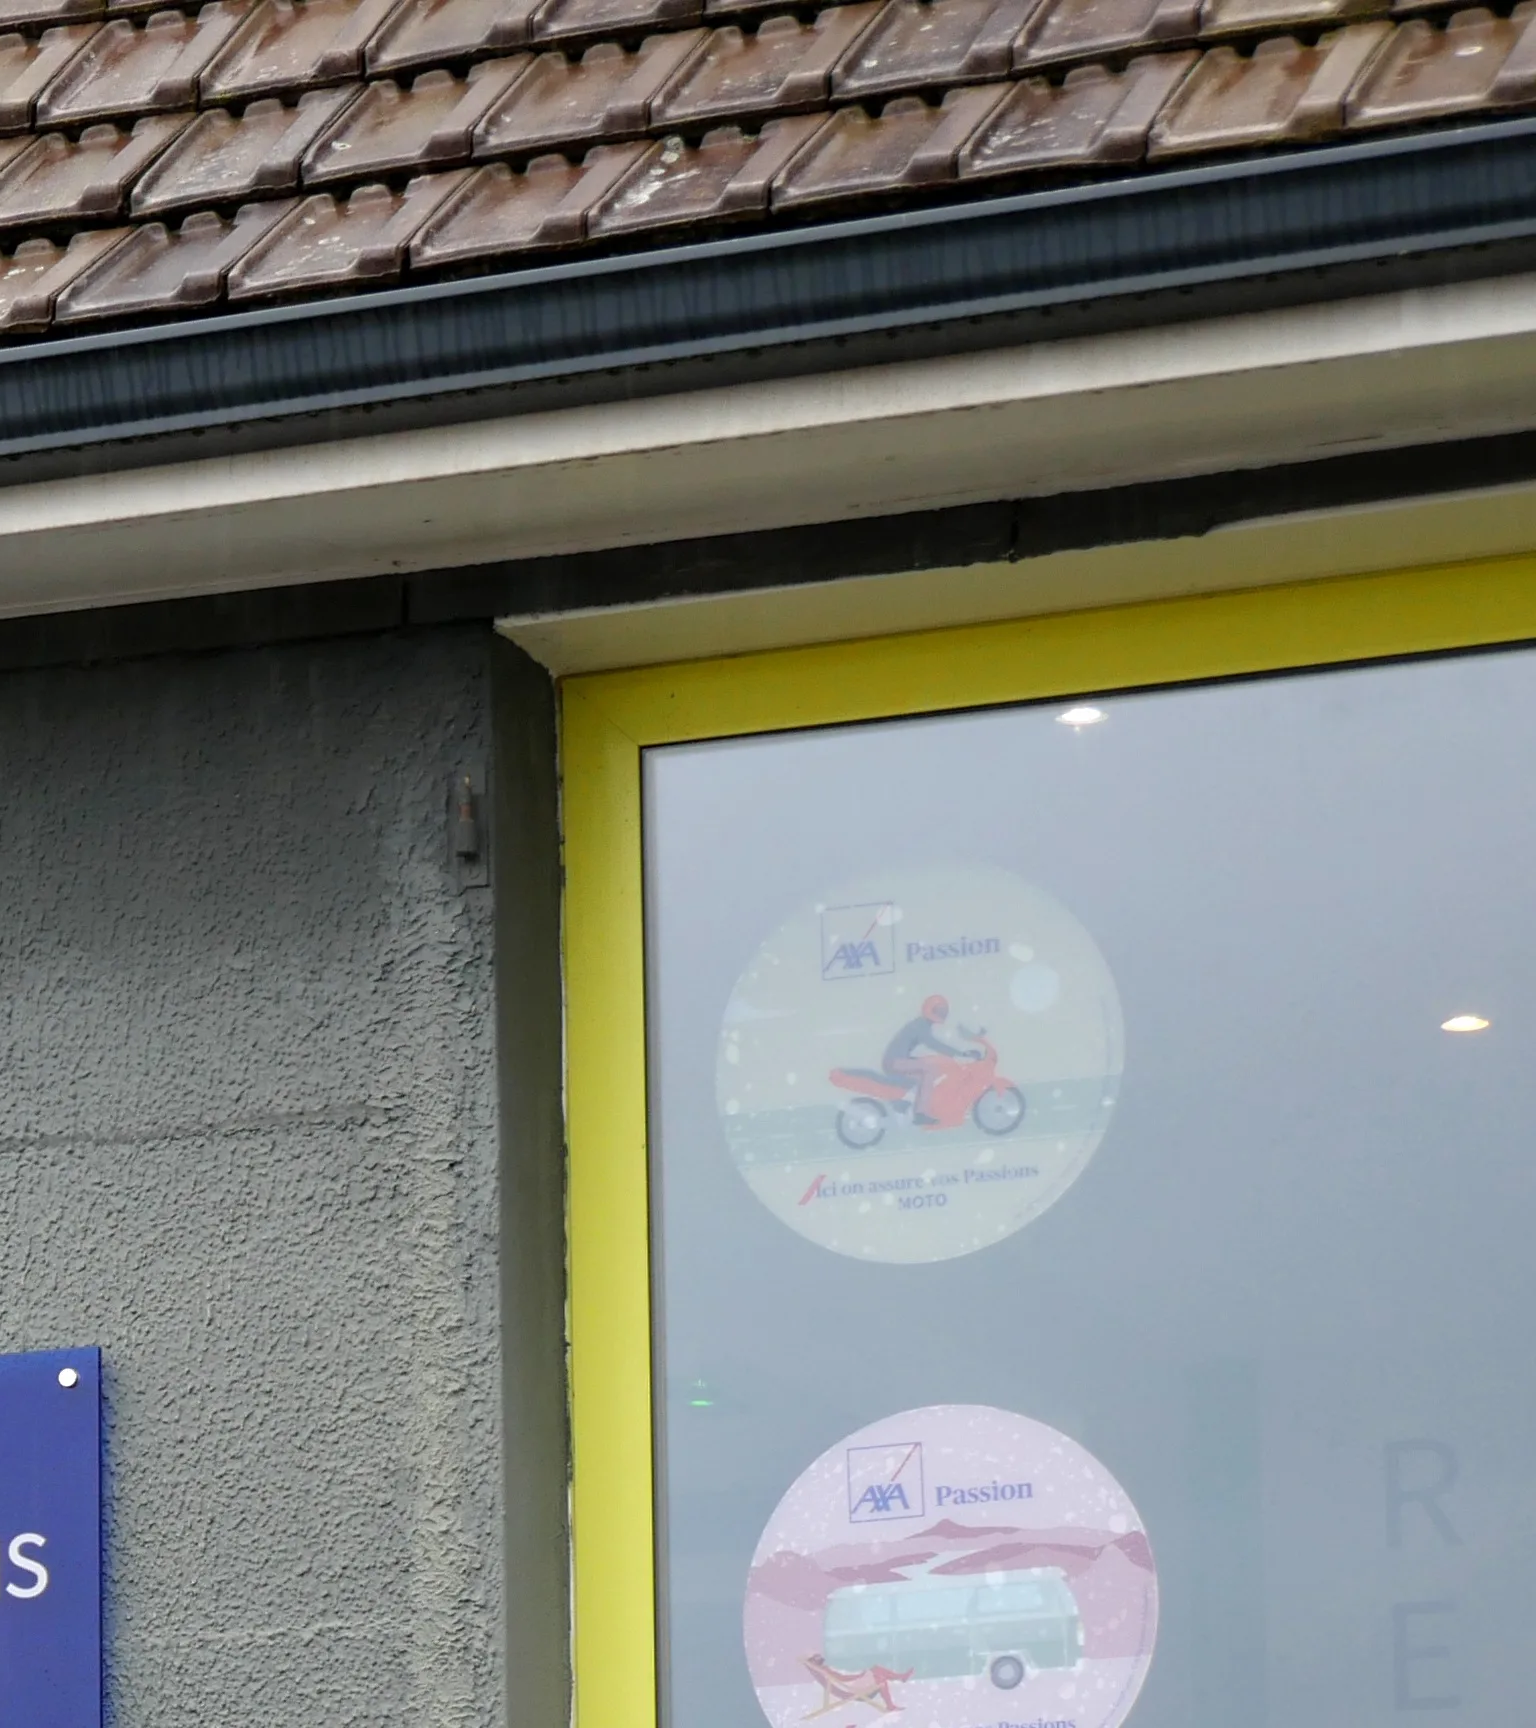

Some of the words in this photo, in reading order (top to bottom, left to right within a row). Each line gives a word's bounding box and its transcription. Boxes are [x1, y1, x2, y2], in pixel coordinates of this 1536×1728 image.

[823, 938, 881, 974] AXA
[905, 936, 1001, 964] Passion
[842, 1181, 864, 1197] on
[868, 1173, 924, 1194] assure
[963, 1162, 1039, 1184] Passions
[897, 1193, 948, 1211] MOTO
[852, 1481, 910, 1514] AXA
[934, 1480, 1033, 1508] Passion
